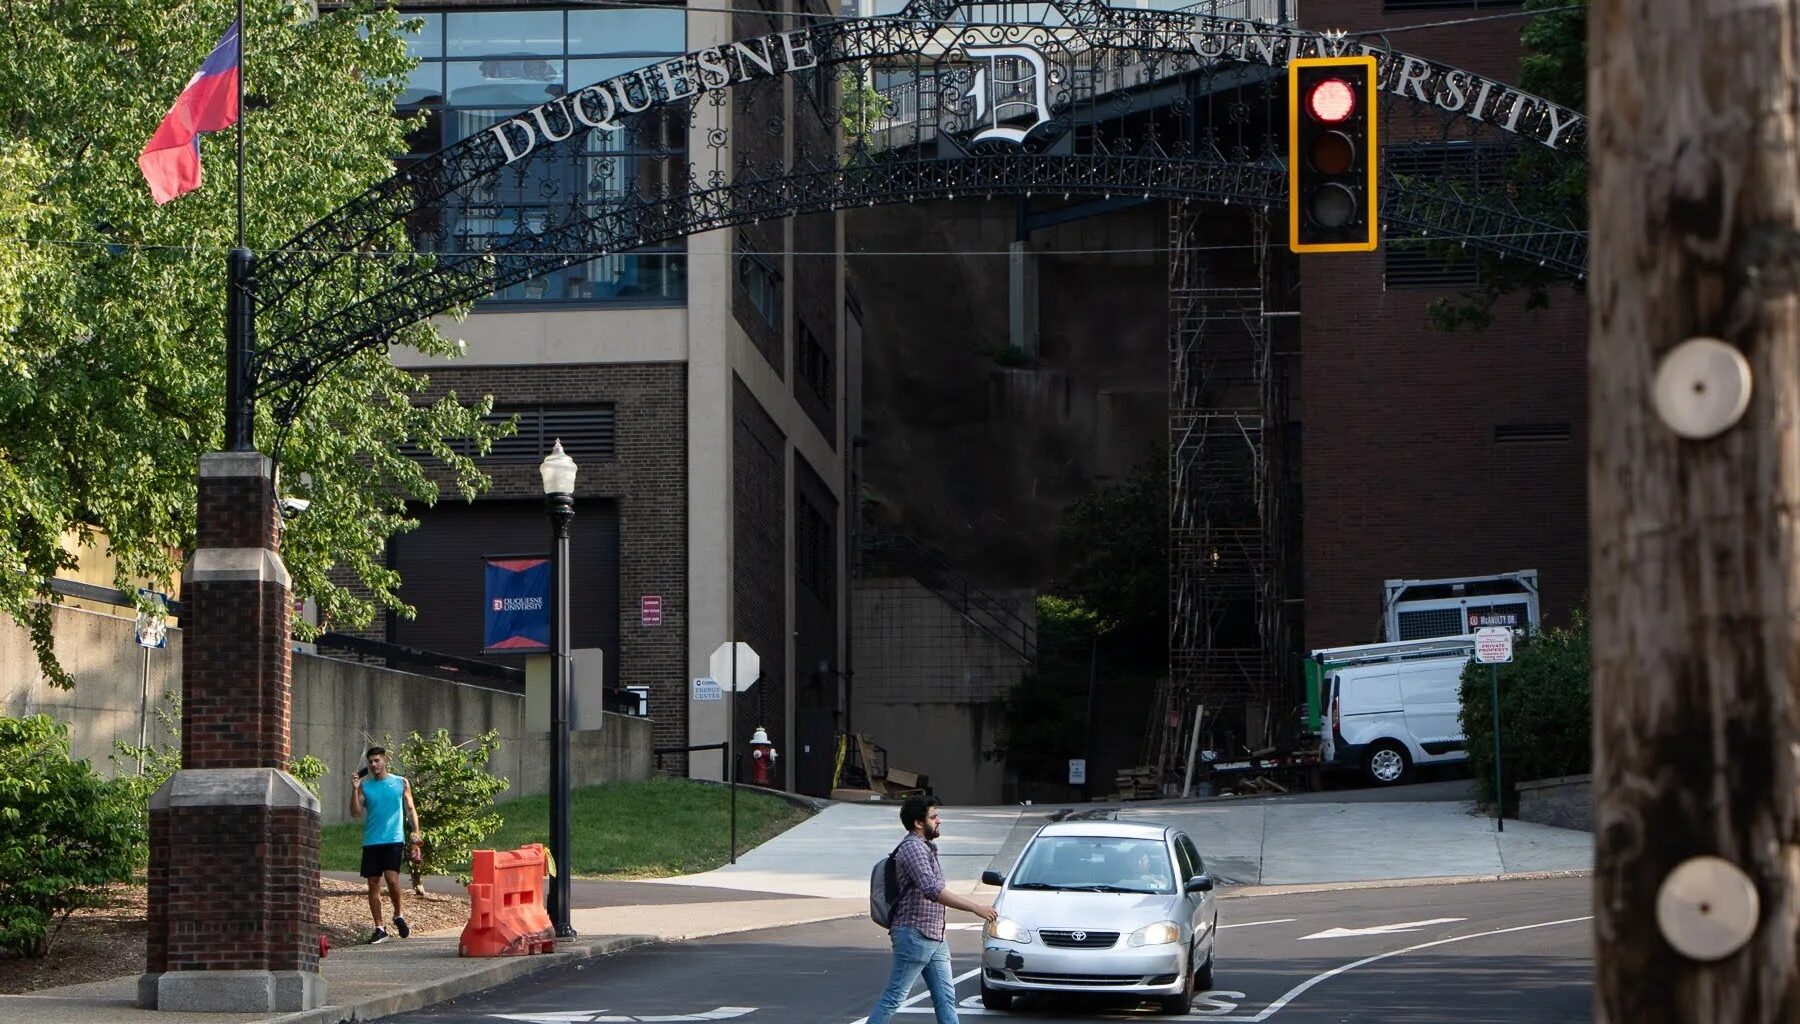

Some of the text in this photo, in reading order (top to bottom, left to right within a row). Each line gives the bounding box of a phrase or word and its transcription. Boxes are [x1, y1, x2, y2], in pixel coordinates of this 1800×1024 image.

[489, 28, 817, 163] DUQUESNE
[962, 46, 1051, 143] D
[504, 603, 543, 611] UNIVERSITY
